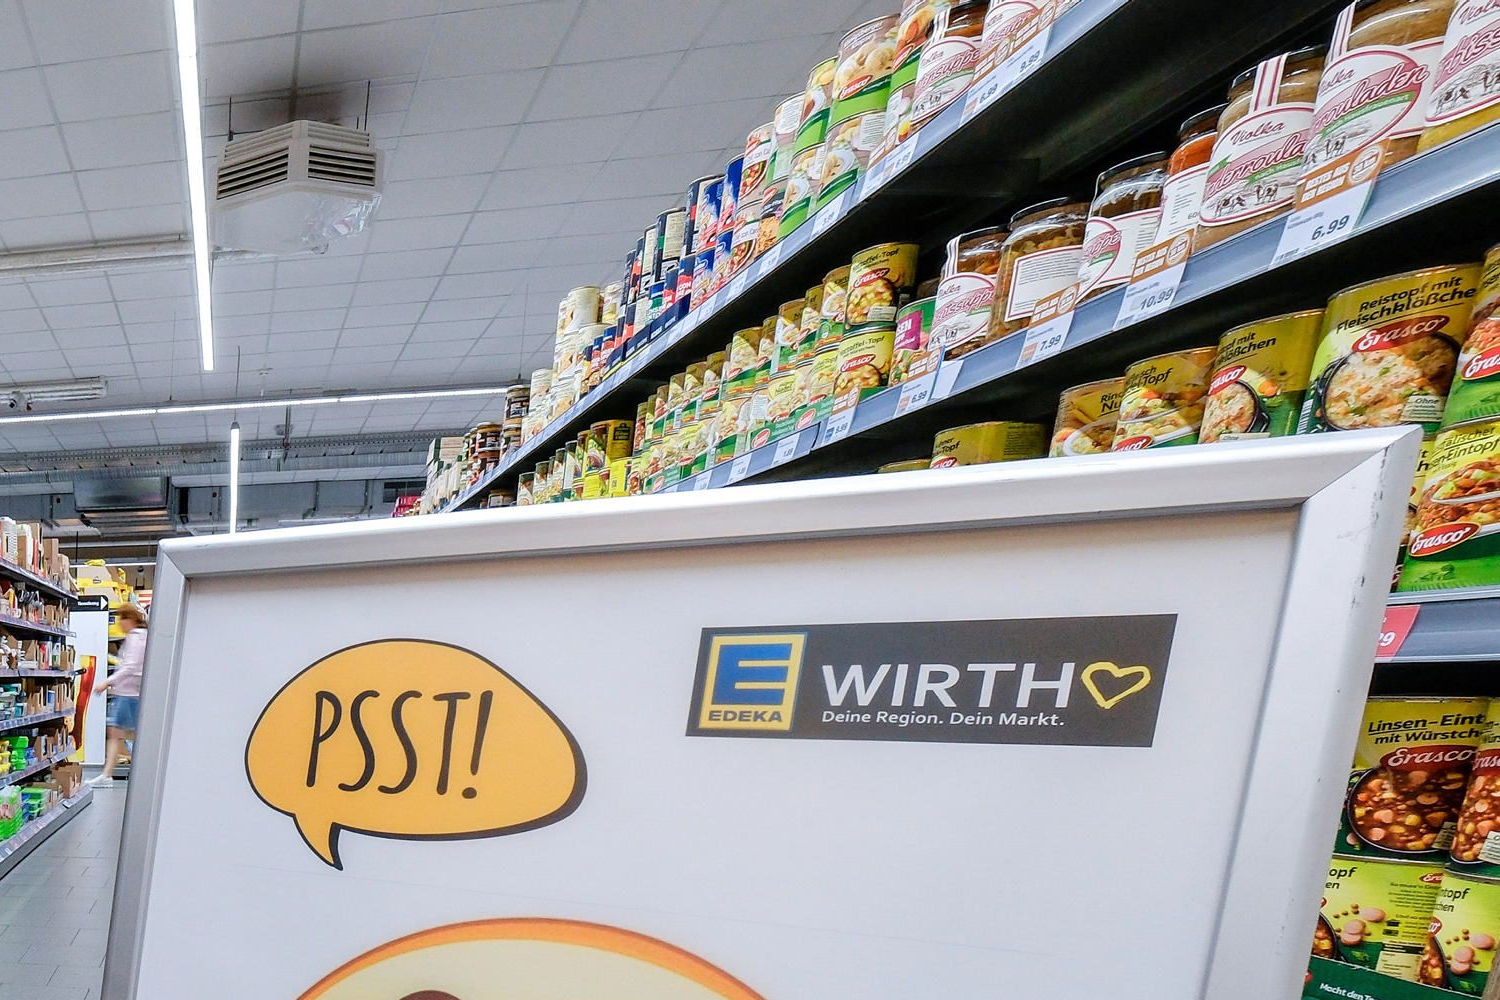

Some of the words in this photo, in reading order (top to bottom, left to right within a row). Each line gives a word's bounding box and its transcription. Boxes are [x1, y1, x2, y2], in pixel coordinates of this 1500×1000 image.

[1229, 119, 1286, 147] Violka
[1311, 214, 1351, 241] 6.99
[1140, 287, 1174, 311] 10.99
[1358, 281, 1429, 313] Reistopf
[1431, 276, 1464, 290] mit
[1335, 286, 1478, 335] Fleischklößche
[1040, 334, 1062, 352] 7.99
[1237, 331, 1257, 346] mit
[1357, 315, 1445, 352] Erasco
[1461, 345, 1500, 379] Eras
[1411, 525, 1471, 556] Erasco
[821, 662, 1076, 709] WIRTH
[707, 709, 784, 724] EDEKA
[821, 710, 872, 724] Deine
[875, 711, 944, 726] Region.
[950, 712, 994, 727] Dein
[998, 712, 1066, 727] Markt.
[1367, 713, 1487, 734] Linsen-Eint
[305, 689, 494, 800] PSST!
[1374, 734, 1401, 746] mit
[1405, 727, 1483, 743] Würstch
[1386, 748, 1477, 768] Erasco
[1319, 981, 1347, 998] Macht
